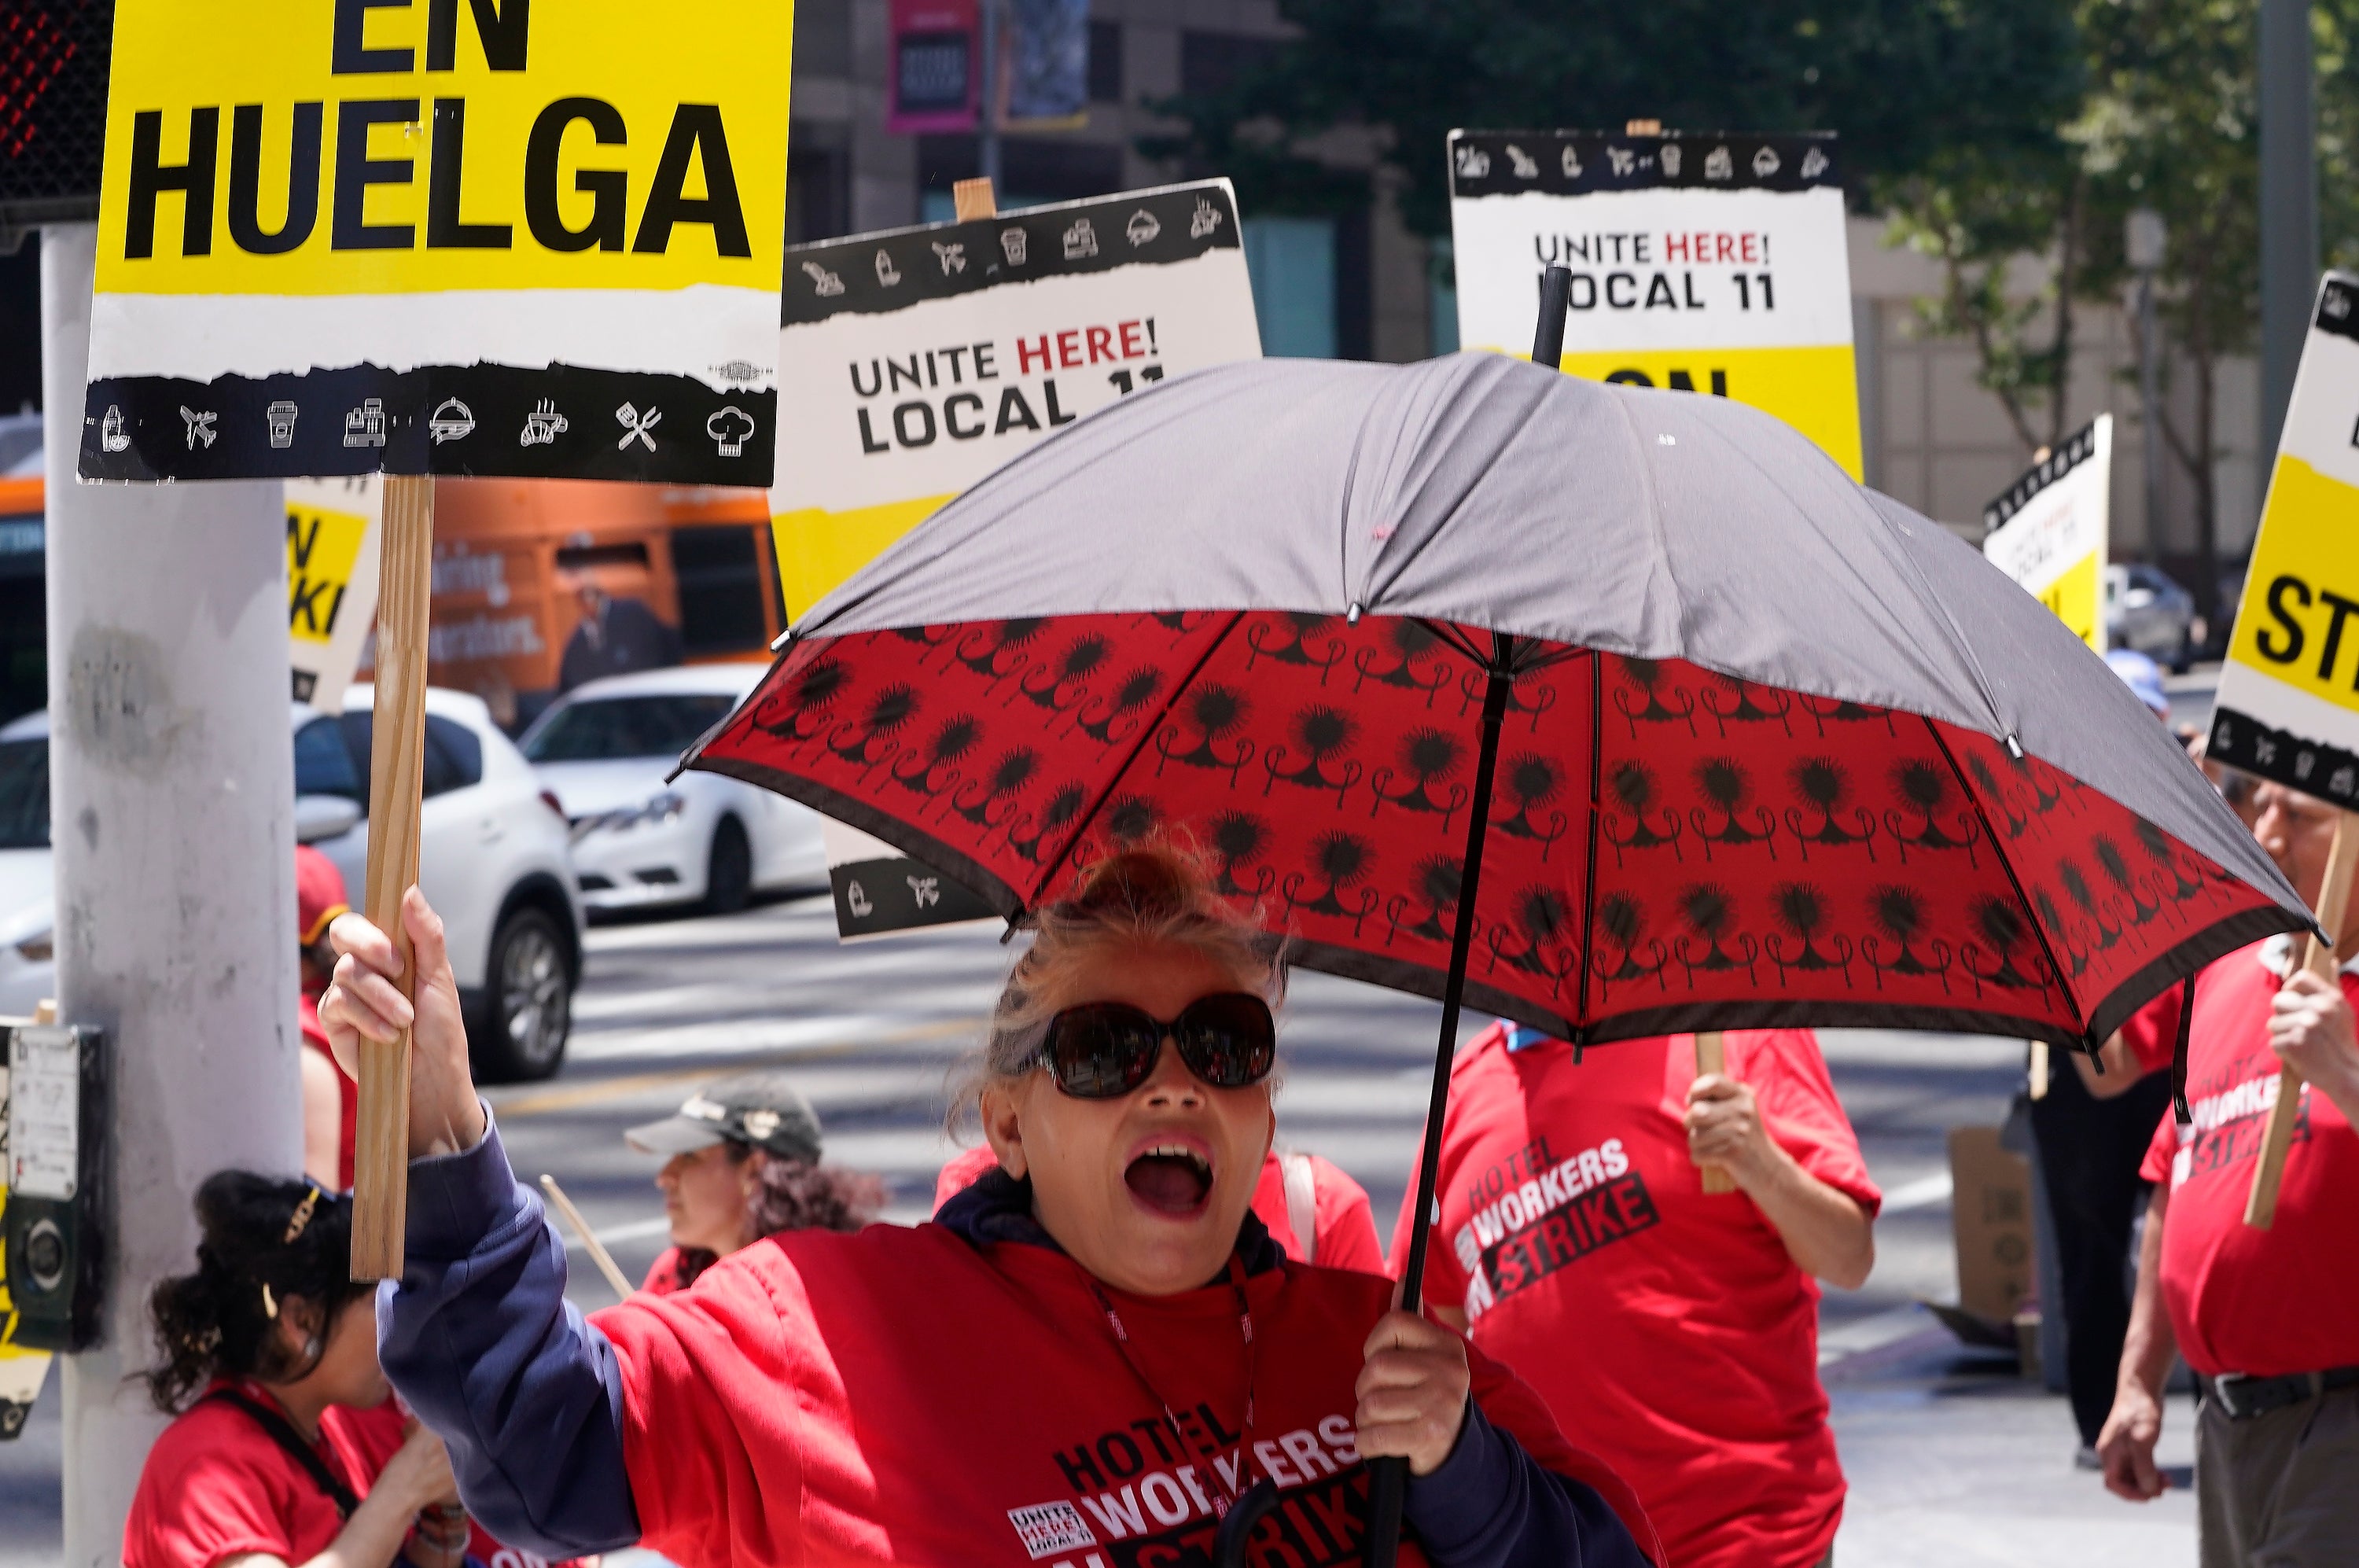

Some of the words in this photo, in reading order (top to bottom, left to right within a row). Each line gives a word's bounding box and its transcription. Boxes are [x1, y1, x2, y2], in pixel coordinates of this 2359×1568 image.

[124, 97, 753, 259] HUELGA
[1534, 234, 1652, 266] UNITE
[1665, 232, 1771, 266] HERE!
[1538, 270, 1706, 311] OCAL
[1732, 271, 1776, 311] 11
[849, 341, 999, 396] UNITE
[1016, 317, 1160, 375] HERE!
[856, 379, 1076, 455] LOCAL
[2256, 572, 2359, 694] ST
[1468, 1135, 1561, 1213] HOTEL
[1472, 1138, 1628, 1248] WORKERS
[1495, 1180, 1651, 1292] STRIKE
[1054, 1402, 1242, 1493] HOTEL
